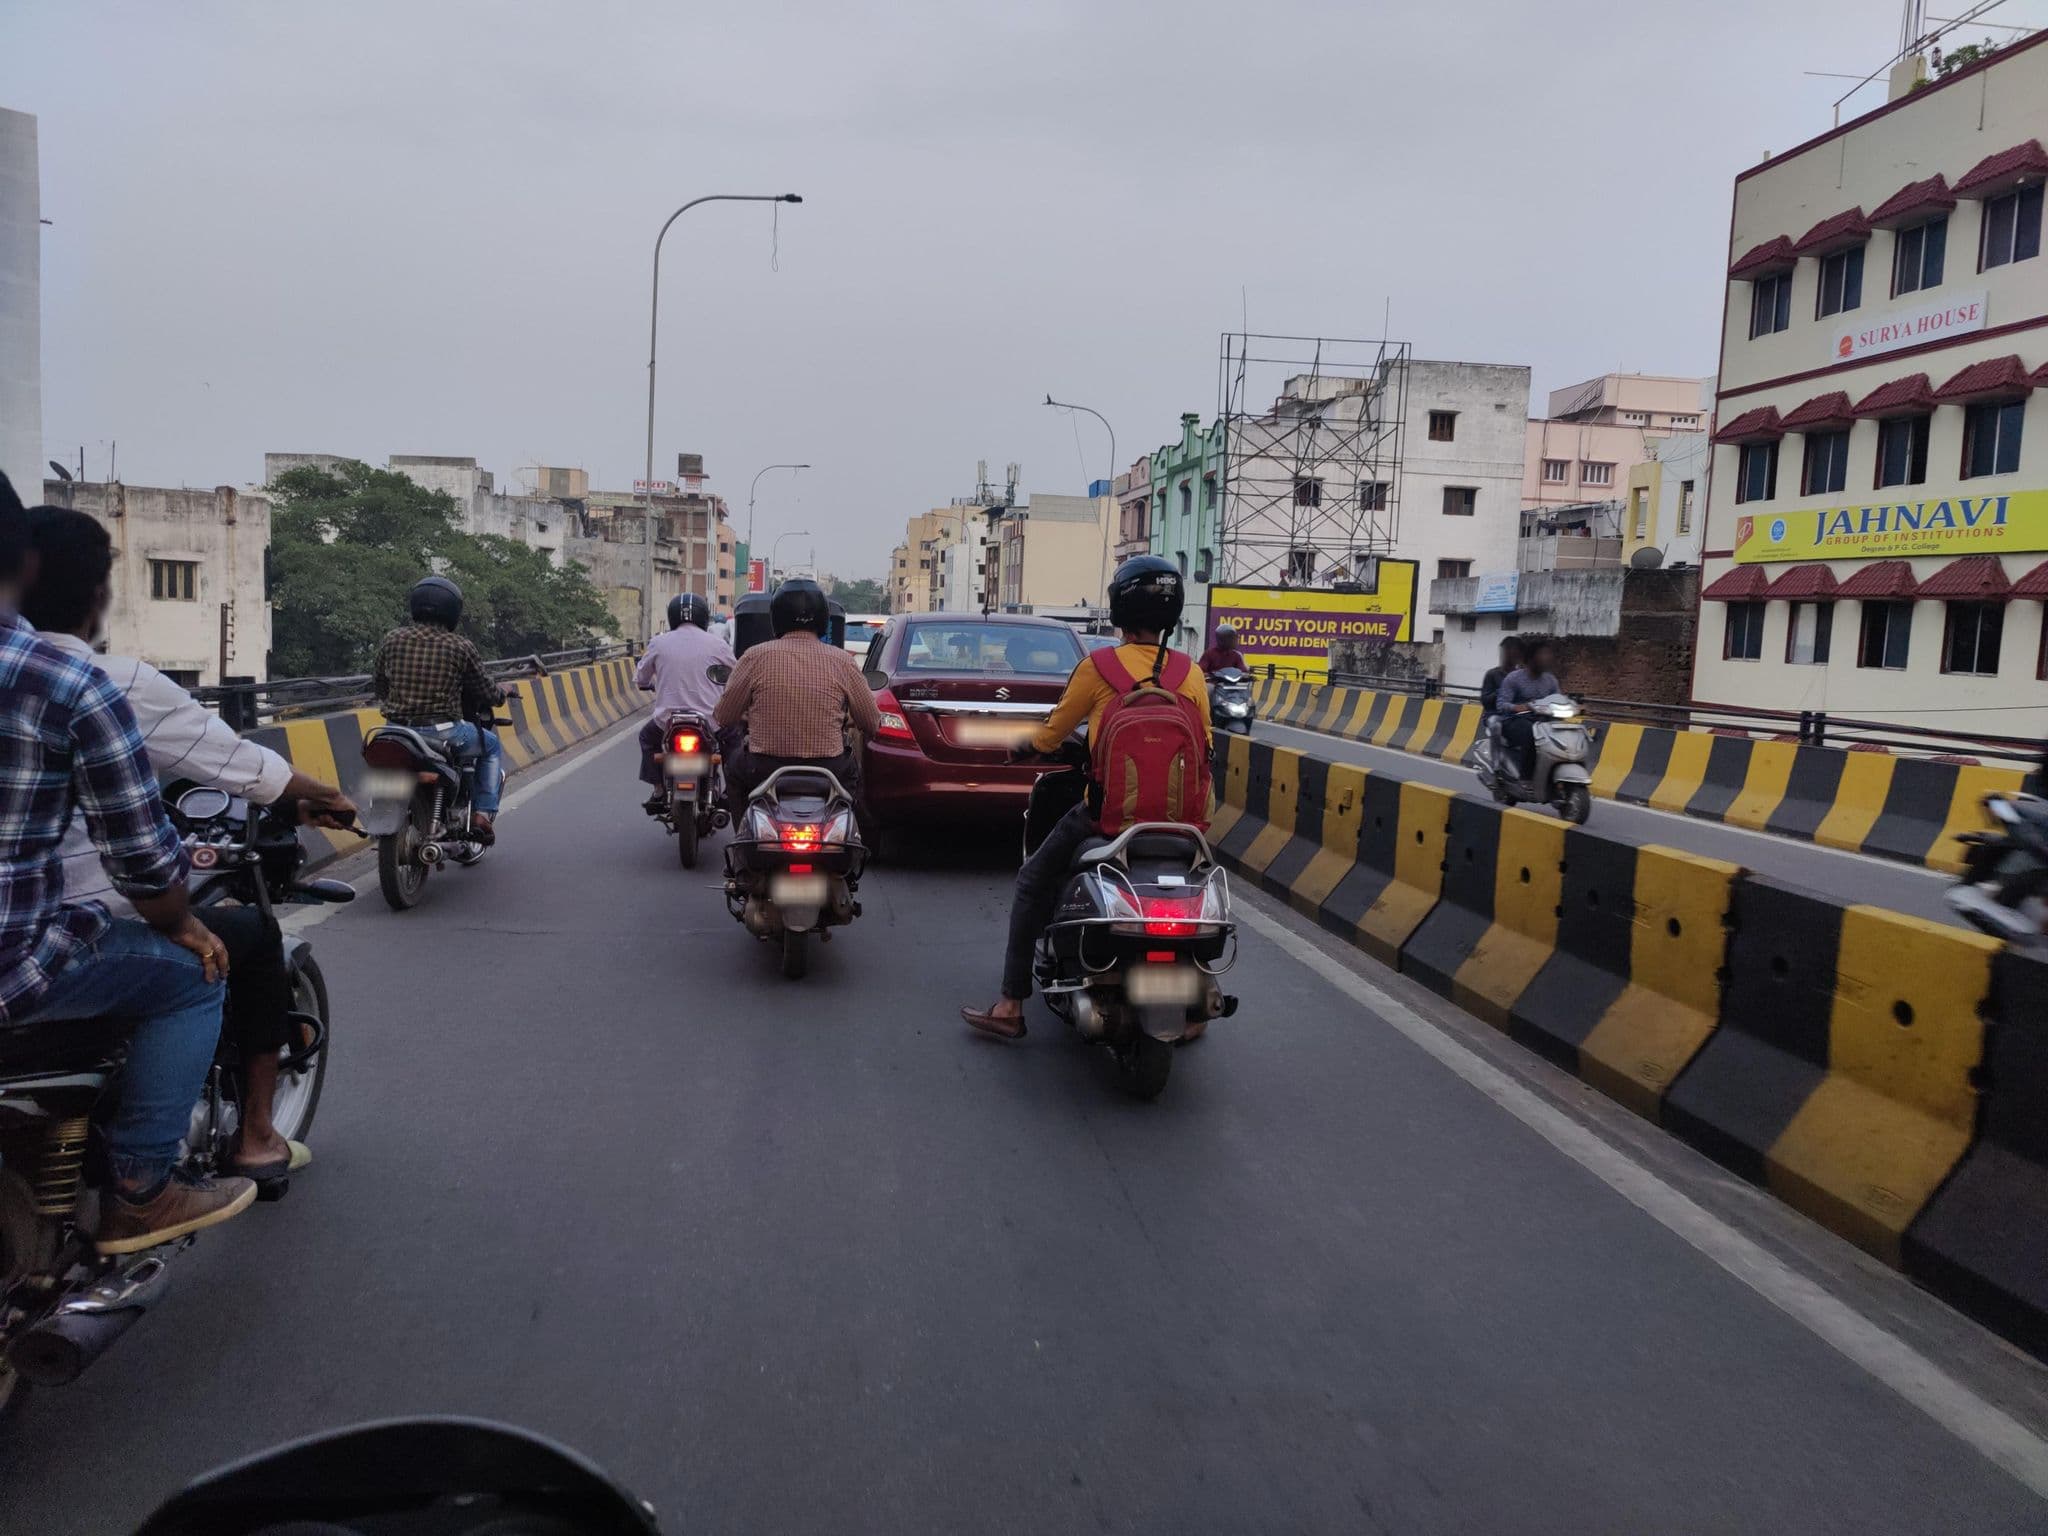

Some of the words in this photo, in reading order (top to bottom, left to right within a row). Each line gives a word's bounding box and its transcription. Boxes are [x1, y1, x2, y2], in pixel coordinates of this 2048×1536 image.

[1859, 322, 1912, 347] SURYA
[1917, 303, 1980, 334] HOUSE
[1814, 496, 2011, 545] JAHNAVI
[1826, 535, 1869, 546] GROUP
[1873, 533, 1890, 543] OF
[1894, 527, 2005, 542] INSTITUTIONS
[1911, 542, 1940, 551] College
[1255, 617, 1292, 631] JUST
[1295, 619, 1337, 633] YOUR
[1341, 621, 1390, 637] HOME,
[1260, 635, 1297, 648] YOUR
